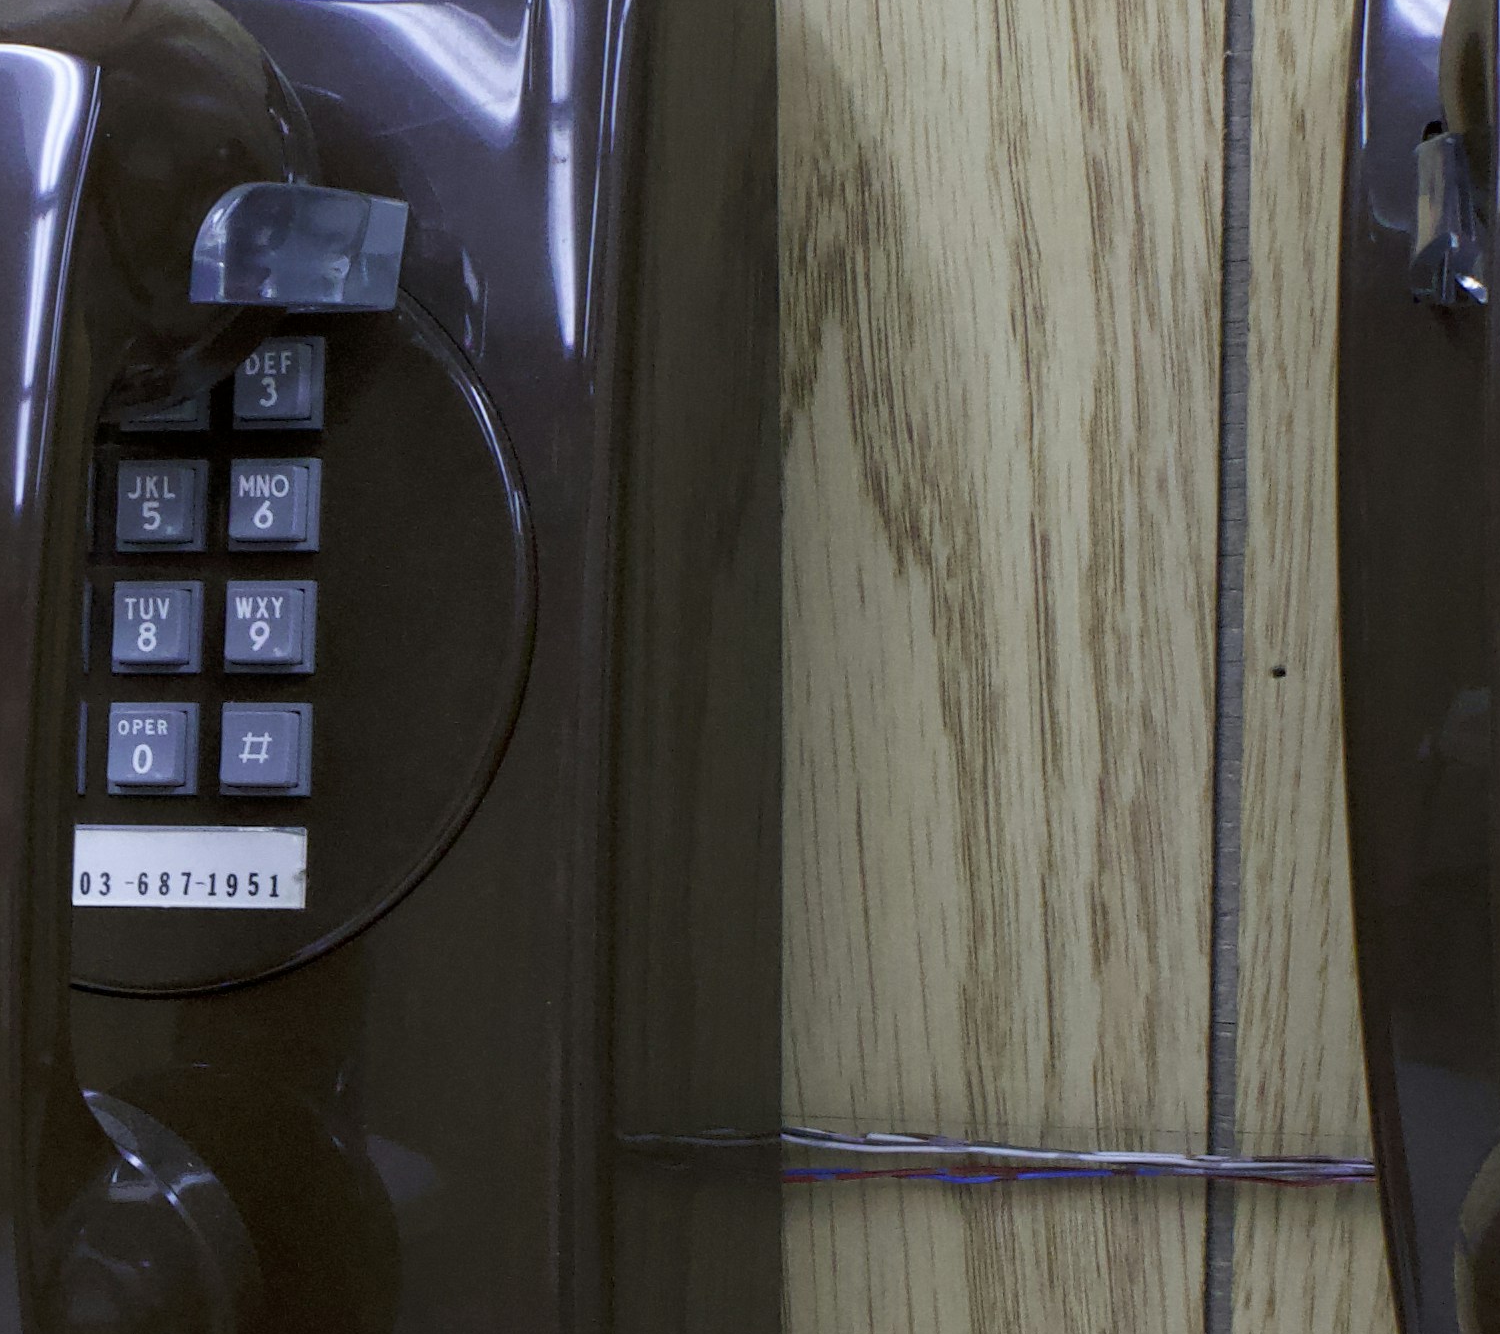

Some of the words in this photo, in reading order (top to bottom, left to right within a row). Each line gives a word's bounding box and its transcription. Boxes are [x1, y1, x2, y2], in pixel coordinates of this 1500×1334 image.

[244, 352, 292, 375] DEF
[259, 377, 278, 407] 3
[128, 475, 175, 499] JKL
[238, 474, 289, 498] MNO
[141, 502, 161, 531] 5
[253, 501, 273, 529] 6
[125, 597, 170, 620] TUV
[235, 596, 284, 619] WXY
[137, 622, 157, 652] 8
[249, 621, 271, 651] 9
[118, 719, 168, 735] OPER
